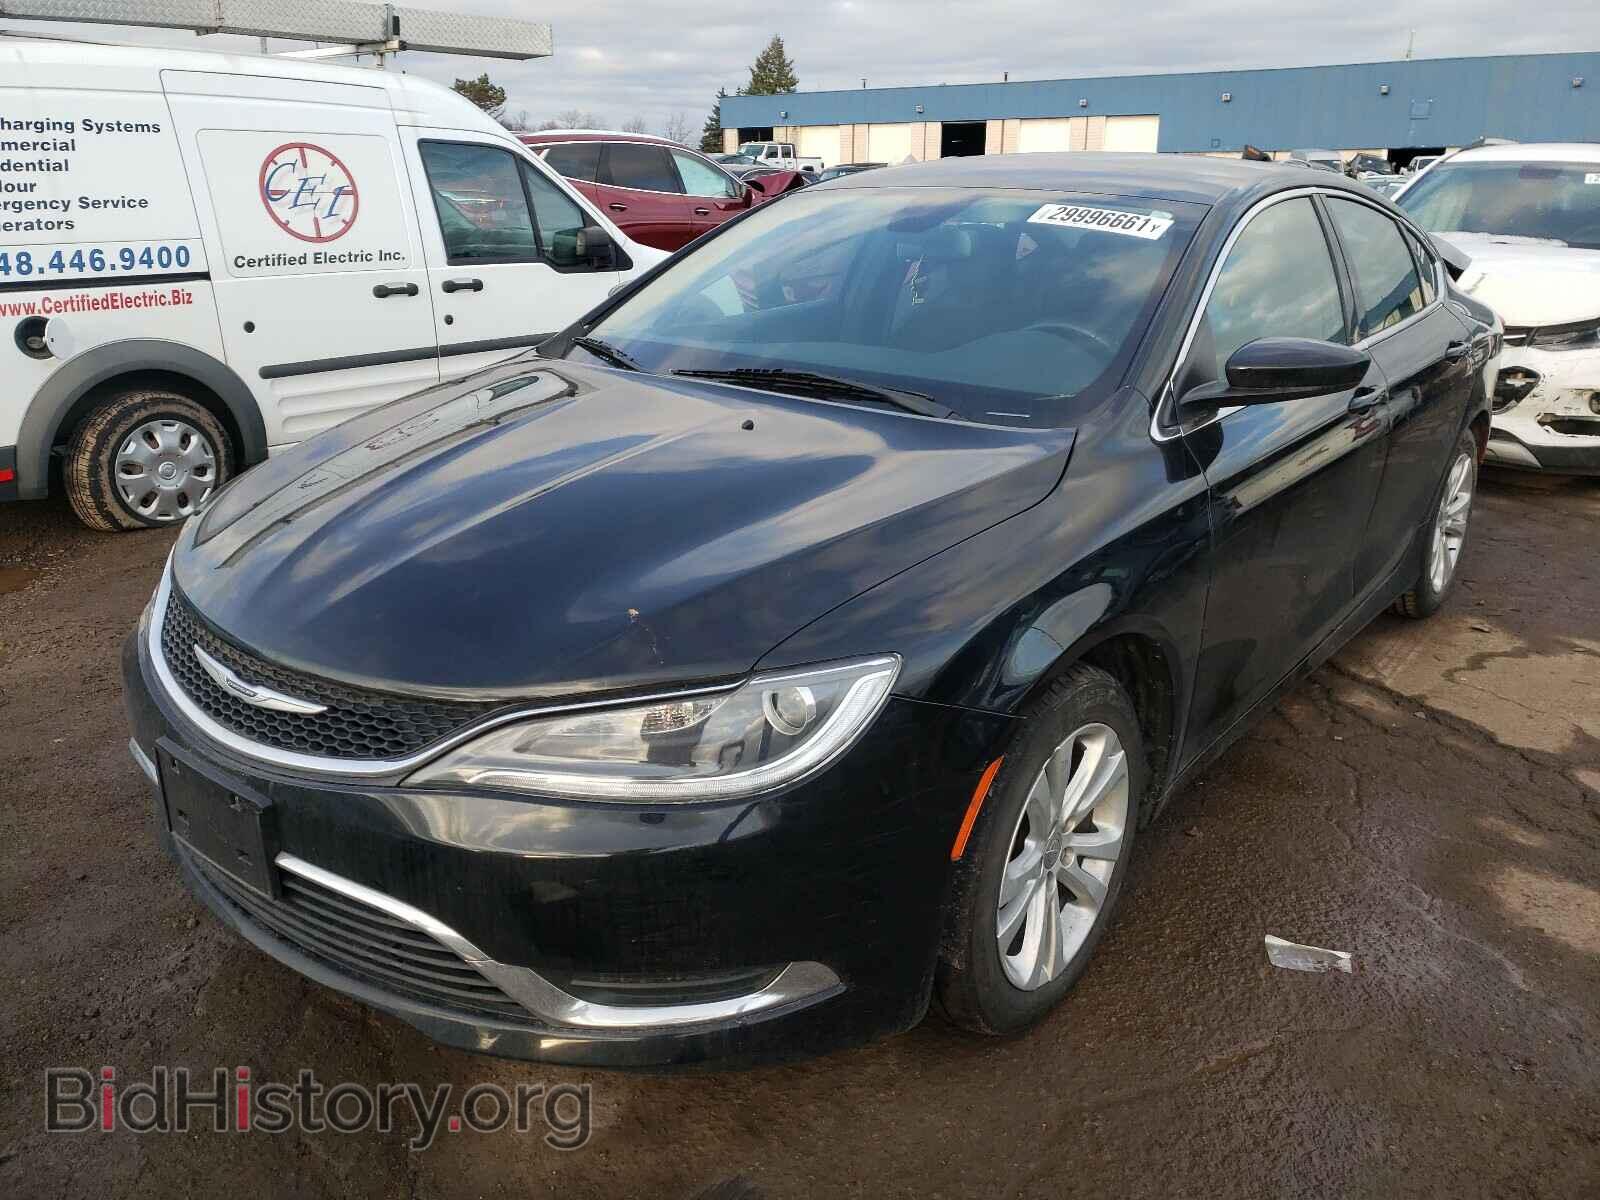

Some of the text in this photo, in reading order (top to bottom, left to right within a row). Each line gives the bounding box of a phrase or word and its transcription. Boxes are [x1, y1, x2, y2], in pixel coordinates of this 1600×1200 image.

[82, 118, 161, 134] Systems
[266, 159, 352, 219] CEI
[0, 196, 149, 213] rgency Service
[0, 218, 75, 232] erators
[1047, 206, 1152, 232] 29996661
[233, 250, 406, 268] Certified Electric Inc.
